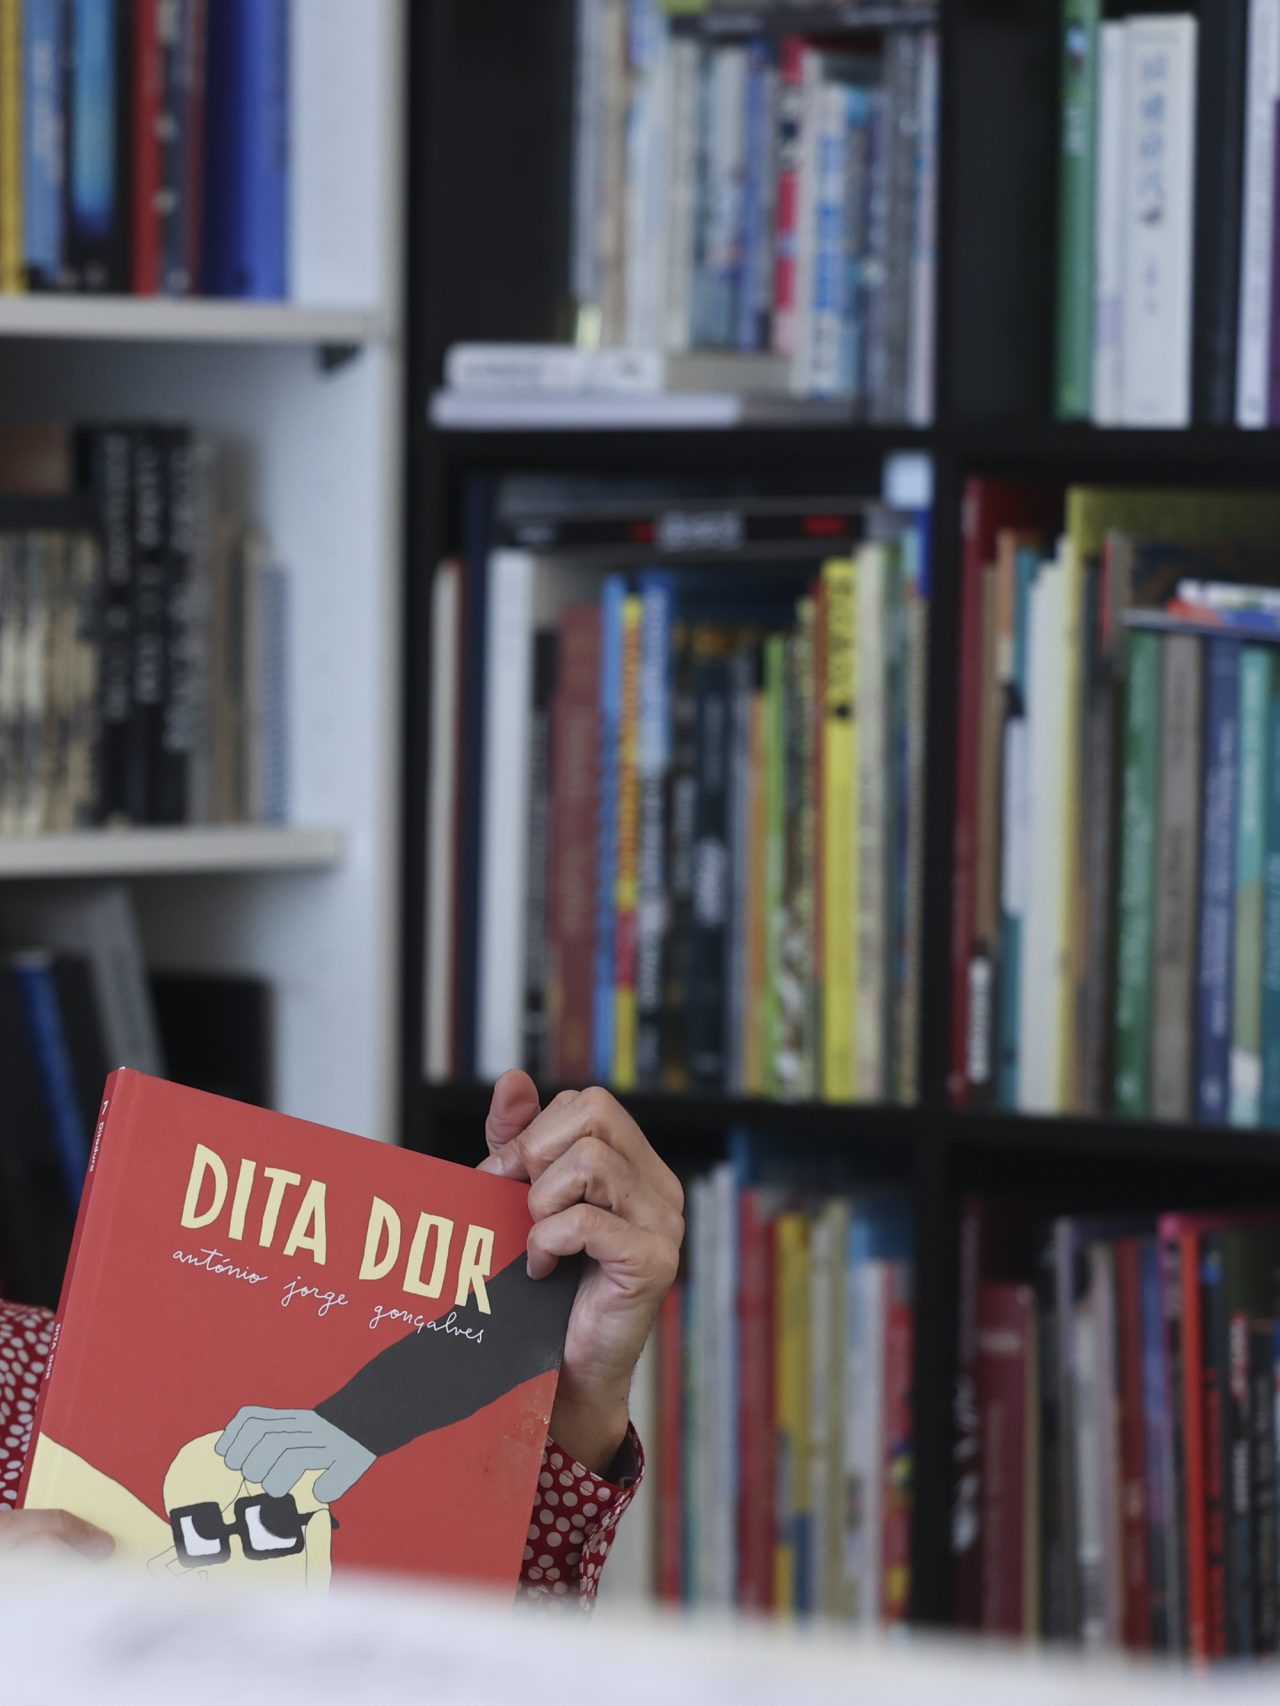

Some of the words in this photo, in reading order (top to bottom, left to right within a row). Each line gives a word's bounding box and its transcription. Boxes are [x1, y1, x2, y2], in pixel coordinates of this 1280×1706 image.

[89, 1121, 105, 1173] Ditadura
[181, 1143, 327, 1265] DITA
[359, 1196, 495, 1315] DOR
[172, 1248, 268, 1284] antónio
[281, 1276, 348, 1317] jorge
[369, 1303, 484, 1344] gonçalves
[51, 1323, 61, 1350] DITA
